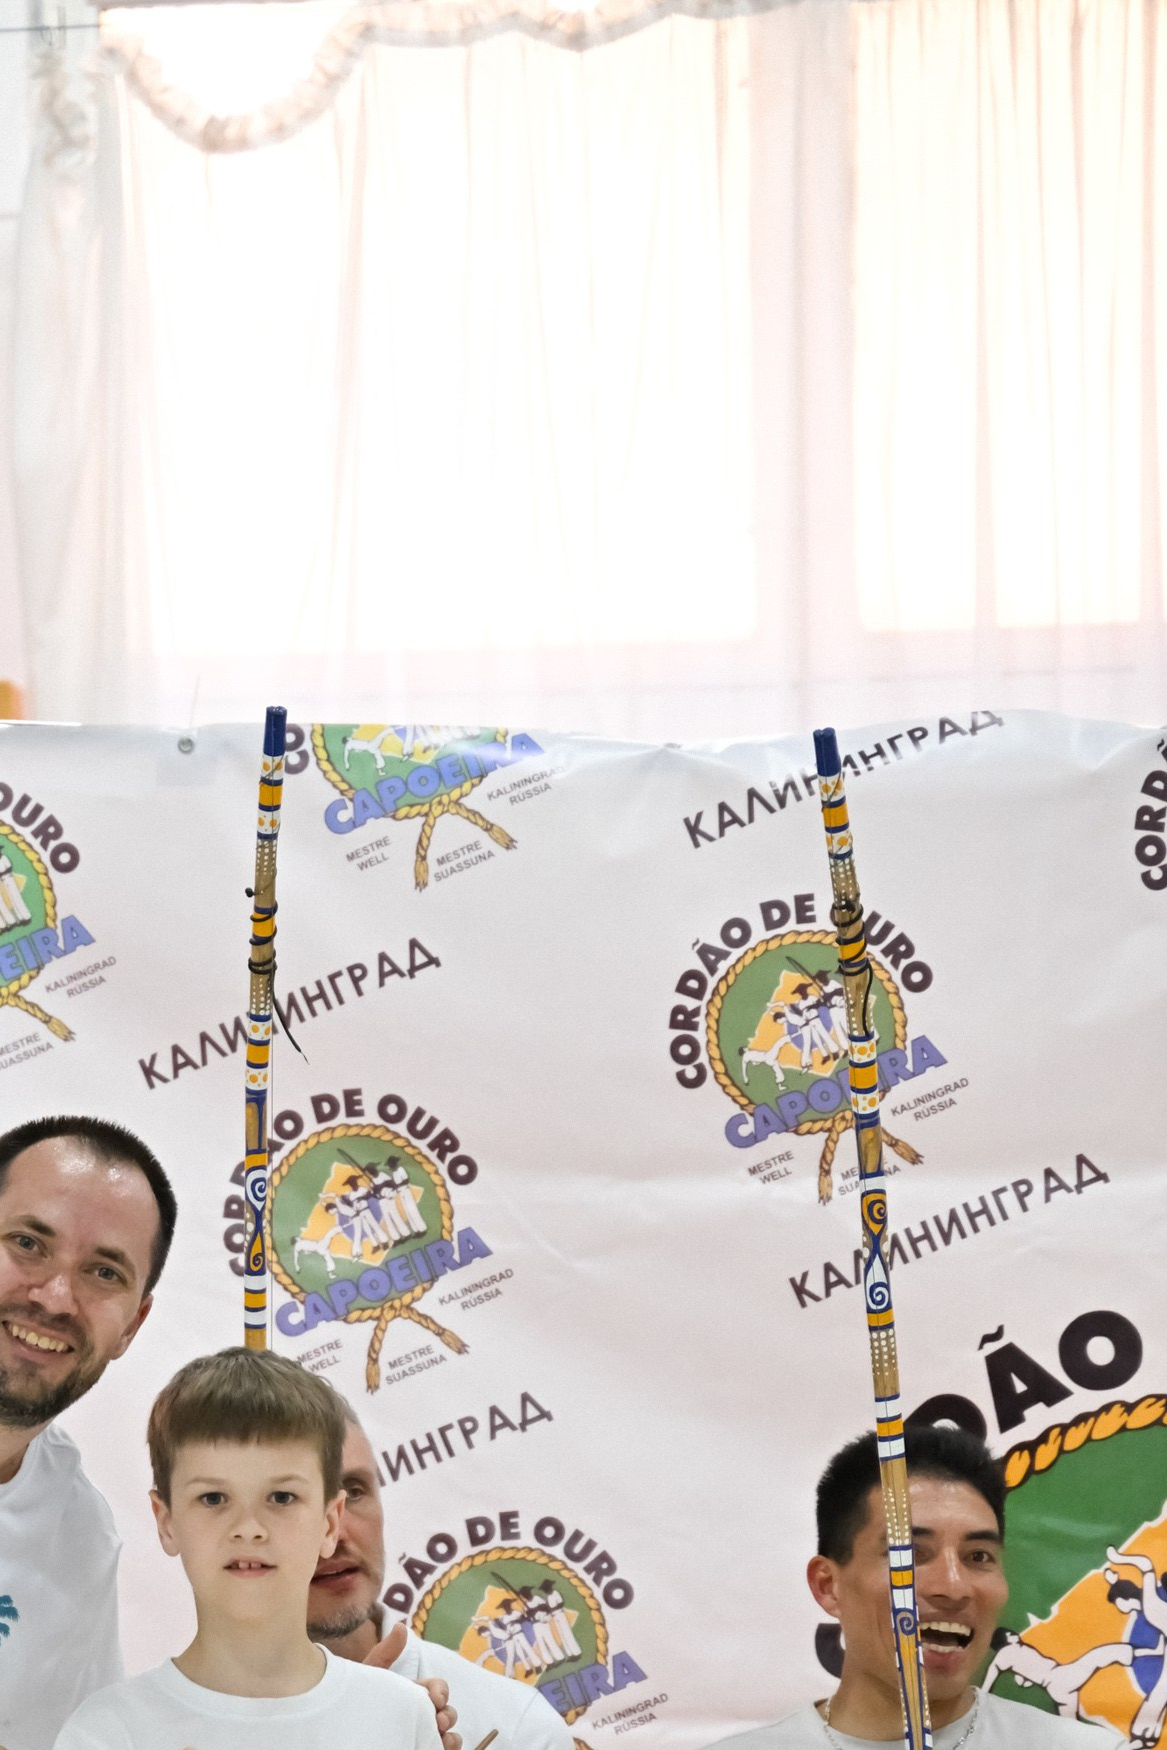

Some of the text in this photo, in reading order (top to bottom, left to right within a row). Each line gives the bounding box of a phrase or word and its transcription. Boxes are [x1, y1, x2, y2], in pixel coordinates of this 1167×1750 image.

[345, 836, 392, 863] MESTRE
[356, 853, 390, 872] WELL
[434, 850, 496, 882] SUASSUNA
[435, 840, 483, 866] MESTRE
[45, 956, 117, 993] KALININGRAD
[669, 893, 933, 1089] CORDÃO DE URO
[138, 937, 441, 1090] КАЛИИНГРАД
[725, 1034, 948, 1149] CAPORA
[891, 1077, 969, 1116] KALININGRAD
[310, 1088, 365, 1124] DE
[377, 1094, 478, 1186] OURO
[748, 1150, 794, 1177] MESTRE
[760, 1167, 792, 1185] WELL
[275, 1226, 493, 1337] CAPOEIRA
[438, 1268, 514, 1305] KALININGRAD
[297, 1339, 343, 1363] MESTRE
[385, 1354, 447, 1385] SUASSUNA
[387, 1345, 434, 1371] MESTRE
[465, 1510, 521, 1548] DE
[533, 1516, 634, 1610] OURO
[592, 1693, 668, 1730] KALININGRAD
